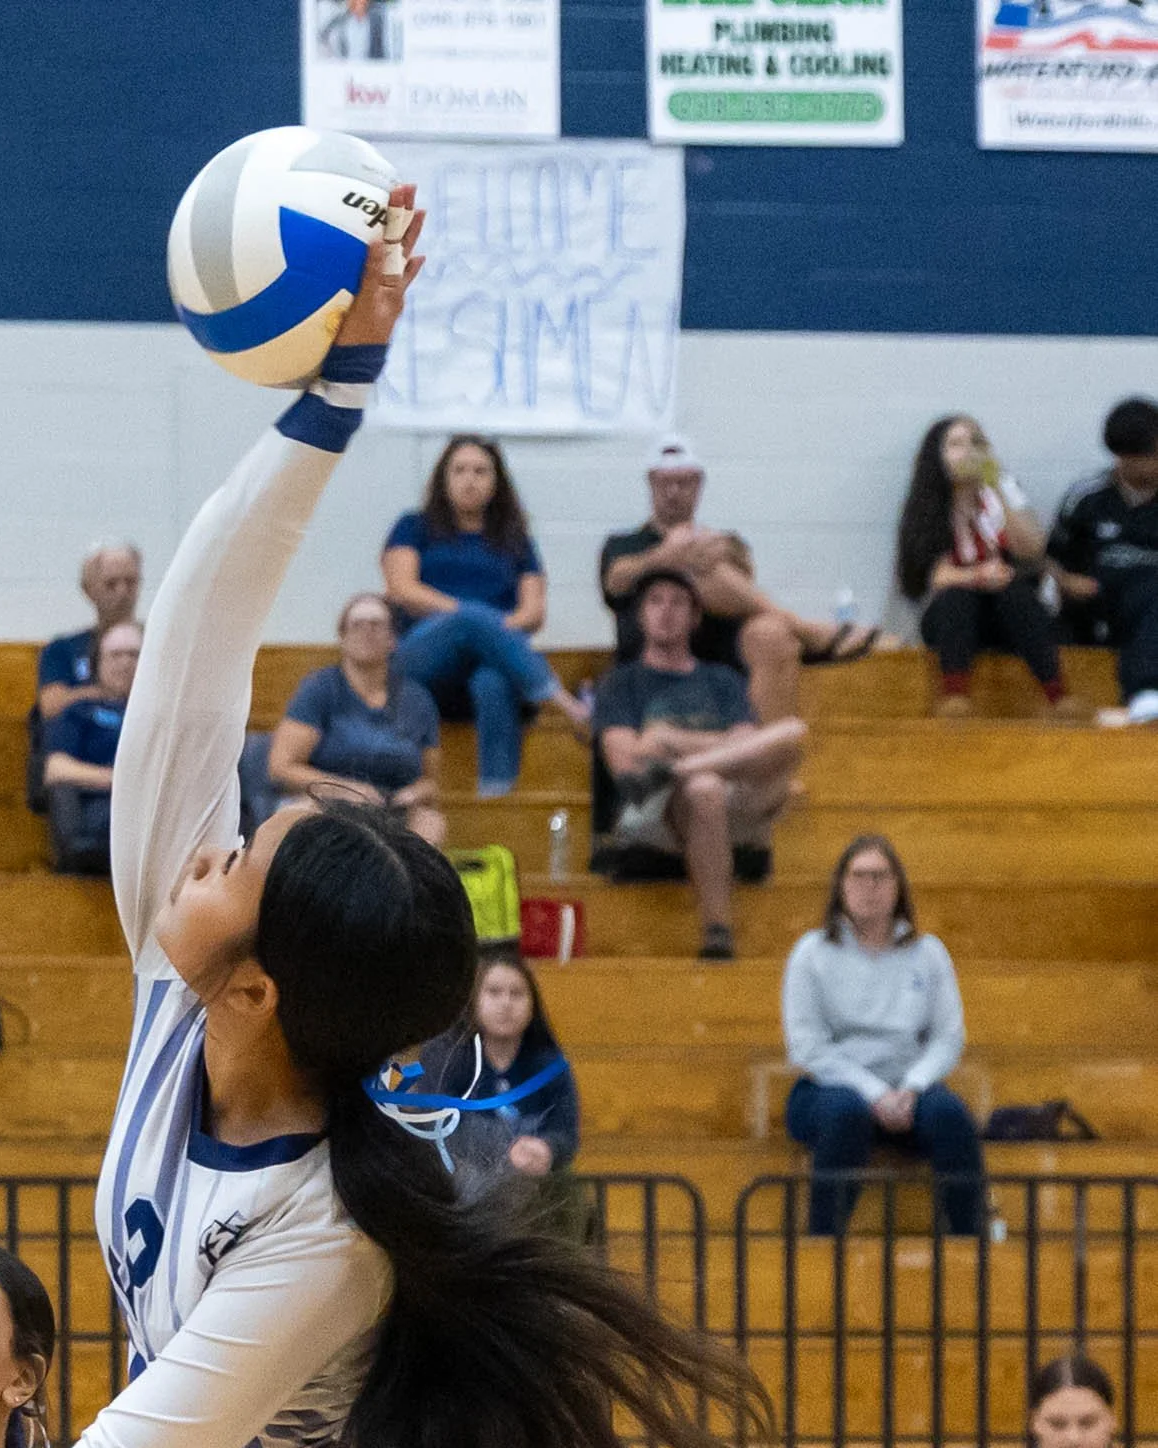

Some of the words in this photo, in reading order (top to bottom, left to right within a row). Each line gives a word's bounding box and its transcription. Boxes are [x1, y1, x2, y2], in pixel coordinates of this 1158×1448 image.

[714, 20, 831, 42] PLUMBING
[660, 54, 754, 76] HEATING
[766, 54, 778, 76] &
[789, 54, 890, 77] COOLING
[346, 78, 389, 105] kw
